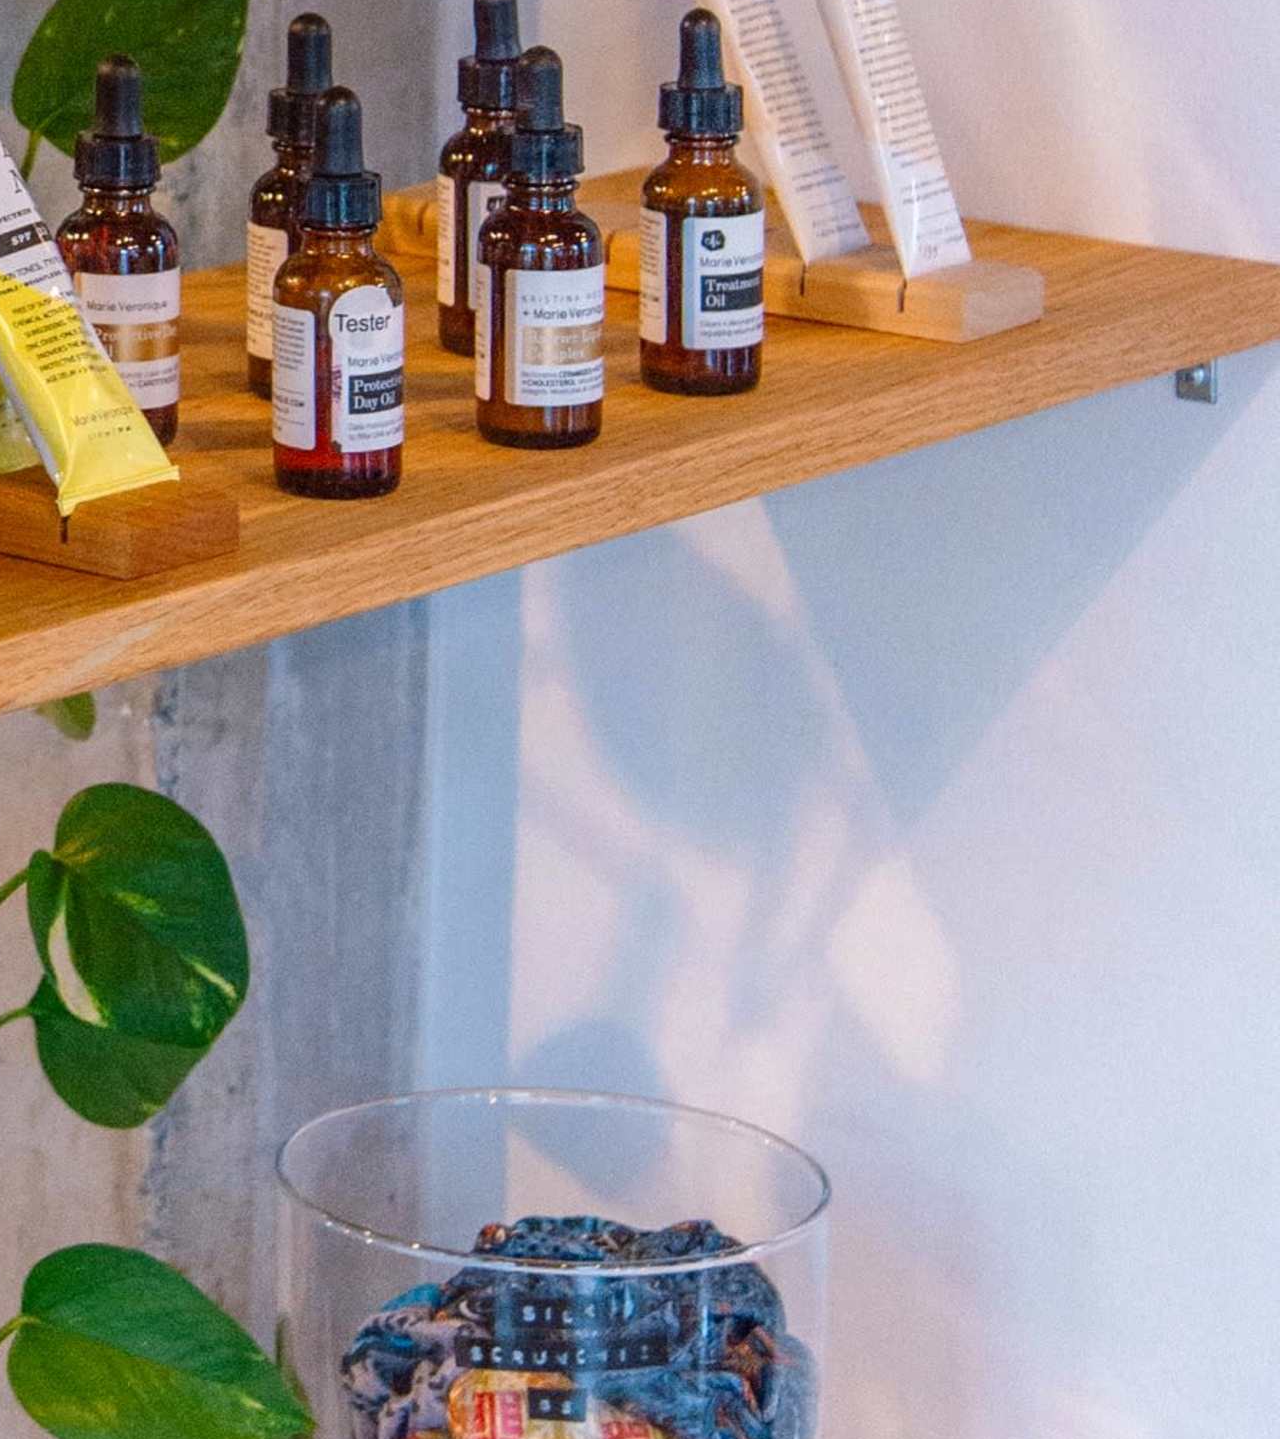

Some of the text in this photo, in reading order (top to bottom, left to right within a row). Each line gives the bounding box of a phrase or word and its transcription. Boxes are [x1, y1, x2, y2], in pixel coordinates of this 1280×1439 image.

[9, 230, 32, 247] SPF
[699, 255, 733, 268] Marie
[86, 298, 168, 313] Marie Veronique
[704, 293, 726, 308] Oil
[533, 308, 568, 320] Marie
[334, 313, 391, 333] Tester
[354, 391, 396, 411] Day Oil
